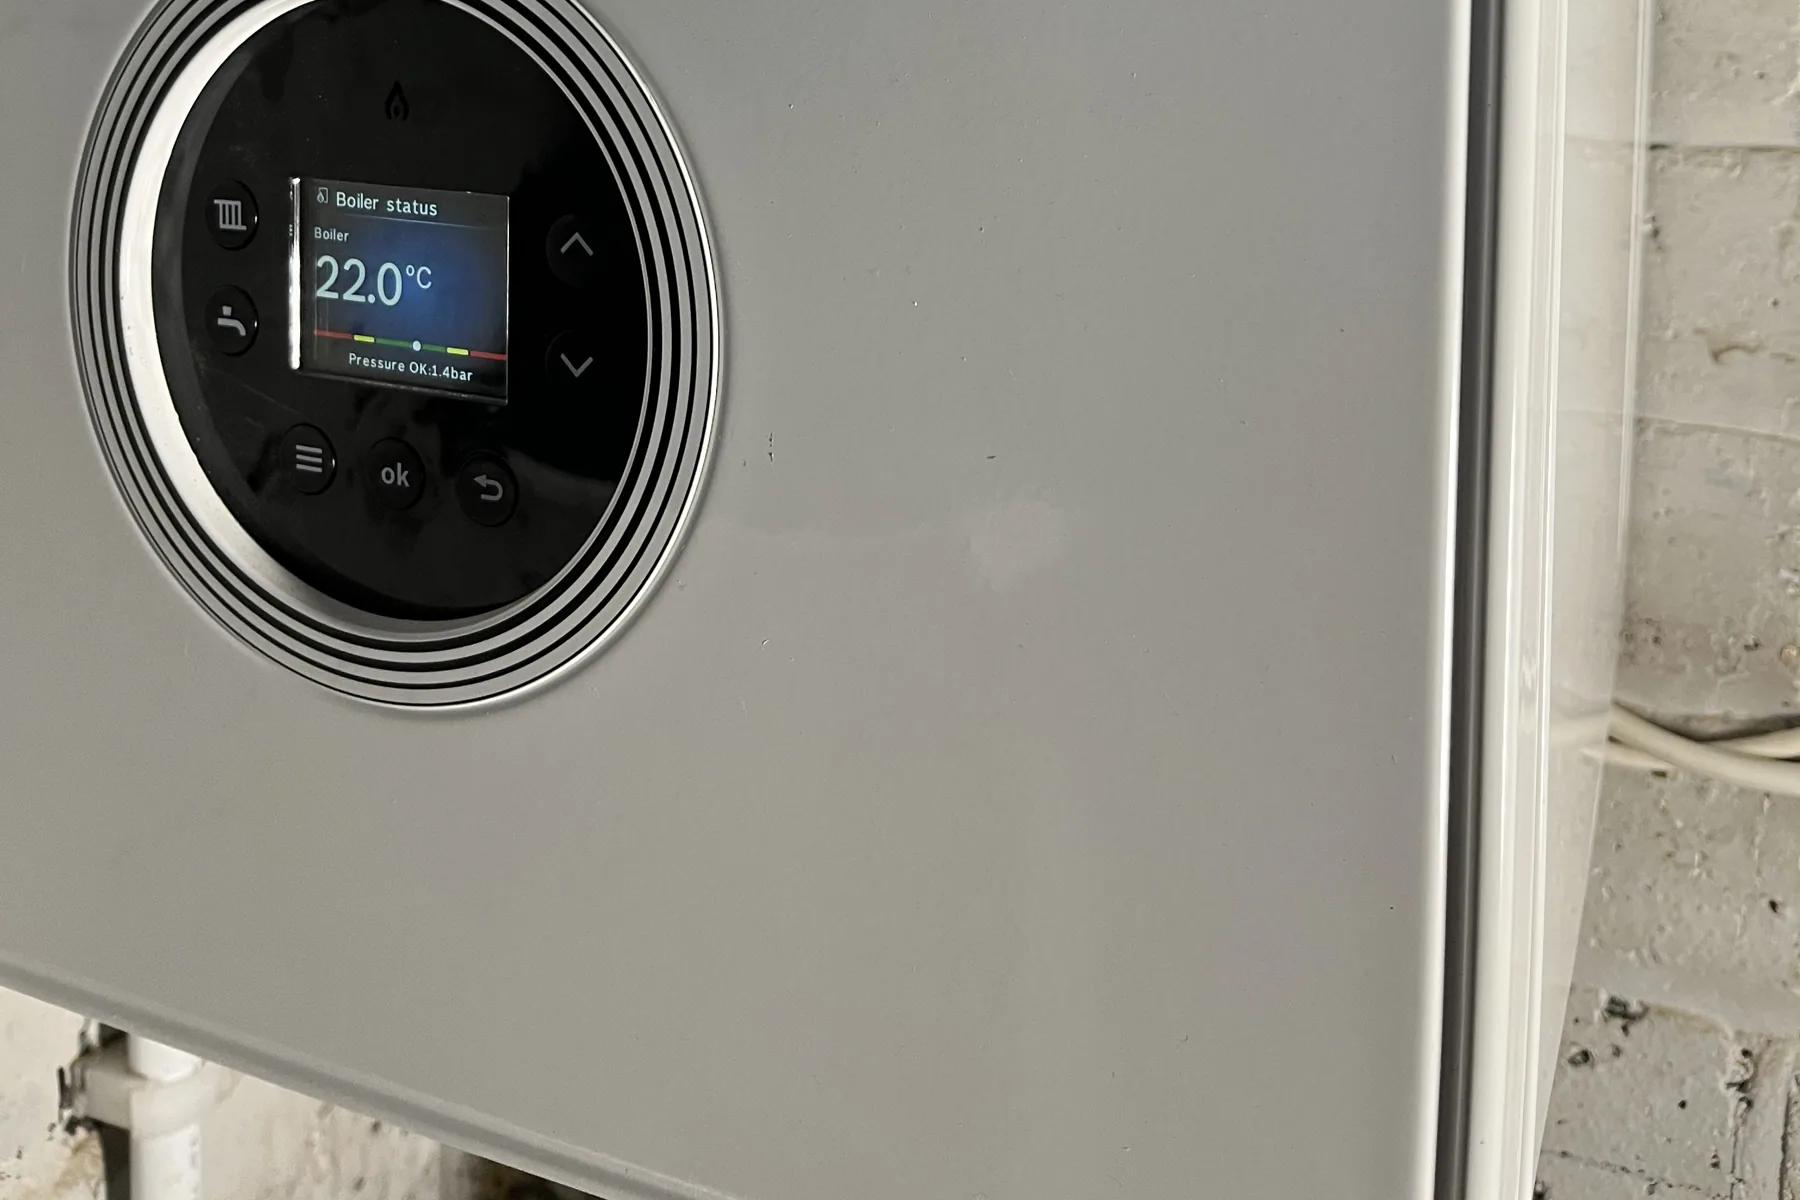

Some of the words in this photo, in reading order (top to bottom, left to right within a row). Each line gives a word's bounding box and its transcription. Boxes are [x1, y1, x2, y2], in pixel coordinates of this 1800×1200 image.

[336, 191, 379, 210] Boiler
[386, 199, 438, 216] status
[314, 226, 349, 242] Boiler
[349, 353, 405, 371] Pressure
[381, 463, 410, 487] ok
